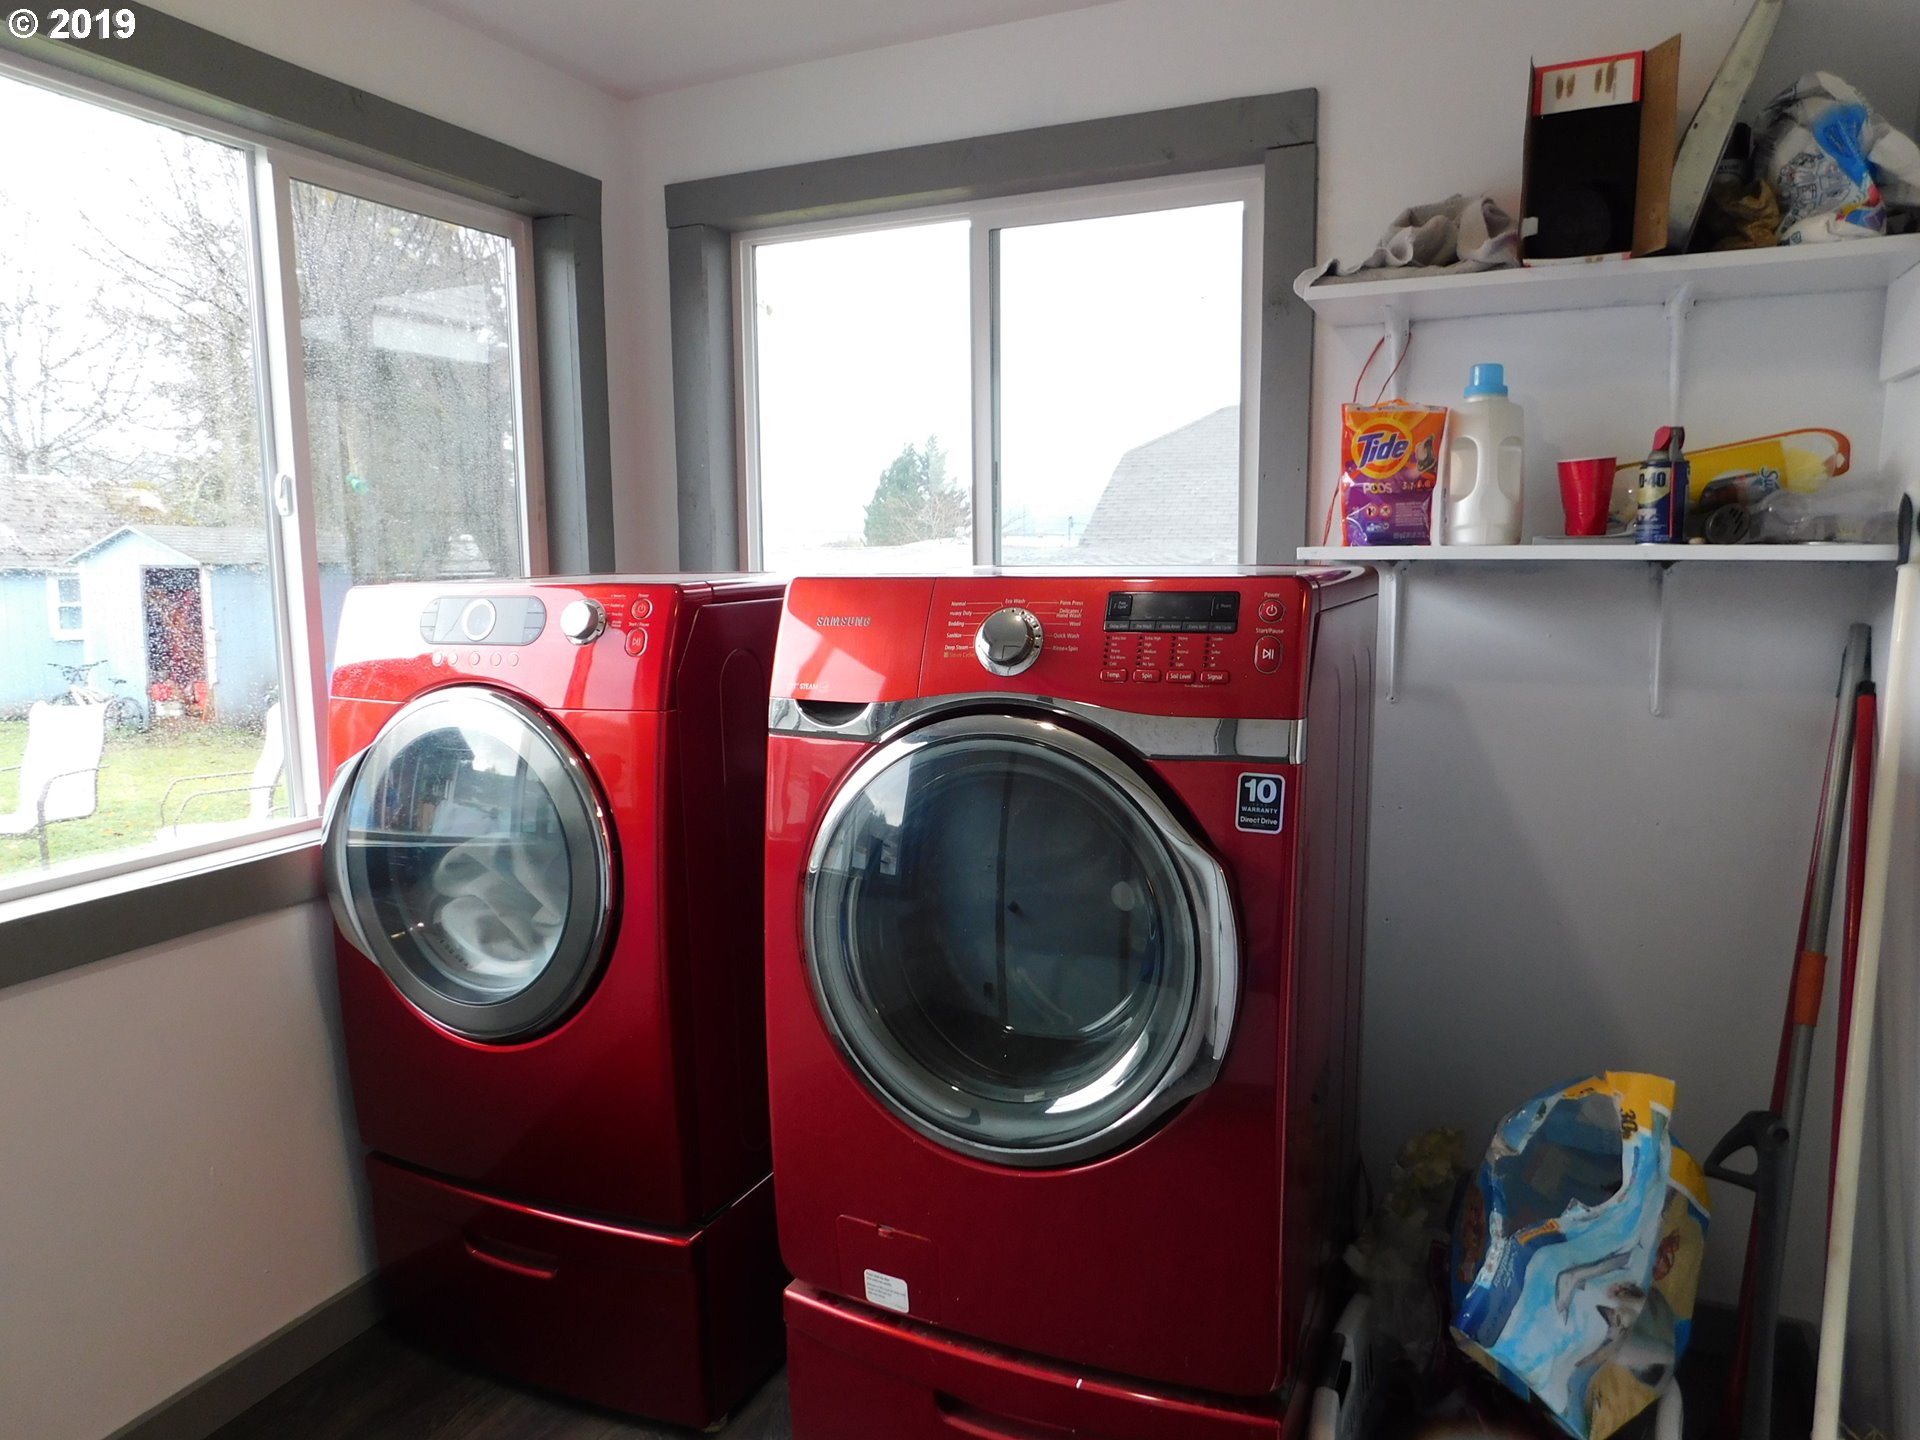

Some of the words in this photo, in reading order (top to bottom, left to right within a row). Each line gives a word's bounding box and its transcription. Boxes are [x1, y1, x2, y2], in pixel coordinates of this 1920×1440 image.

[1357, 431, 1411, 469] Tide
[1639, 471, 1666, 488] D-40
[1363, 482, 1393, 495] PODS
[816, 616, 871, 628] SAMSUNG
[1142, 672, 1153, 680] Spin
[1208, 673, 1223, 681] Signal
[1244, 778, 1277, 804] 10
[1241, 806, 1278, 814] WARRANTY
[1240, 816, 1260, 824] Direct
[1260, 817, 1278, 826] Drive
